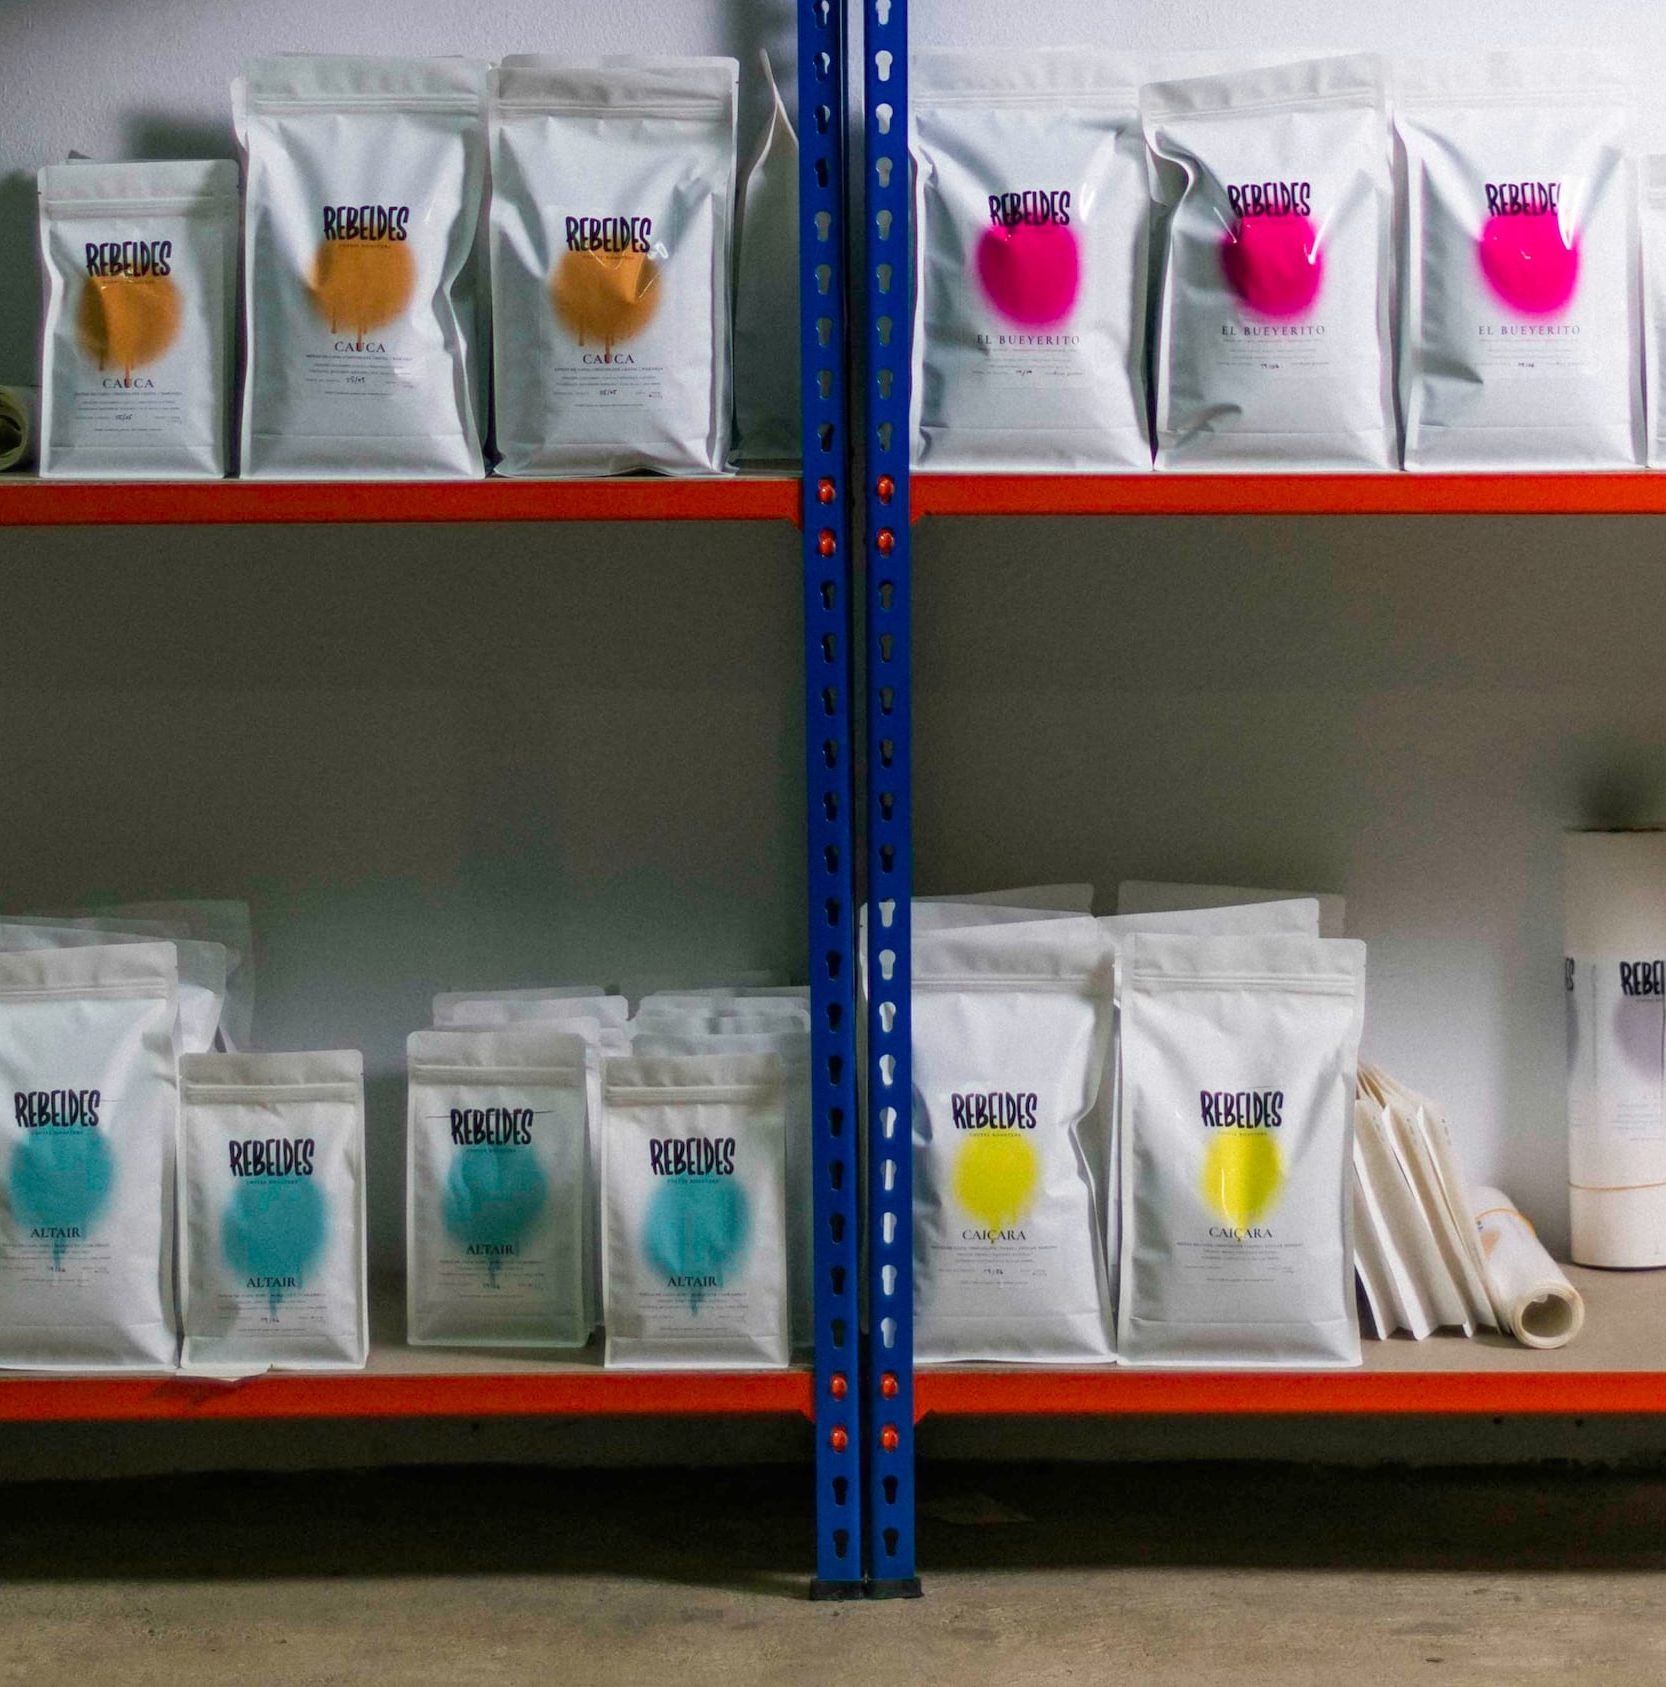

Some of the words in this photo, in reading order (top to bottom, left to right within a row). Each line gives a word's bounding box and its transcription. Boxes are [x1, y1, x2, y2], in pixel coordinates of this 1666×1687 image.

[989, 190, 1071, 226] REBELDES
[1227, 182, 1311, 217] REBELDES
[1485, 182, 1561, 216] REBELDE
[323, 206, 409, 242] REBELDES
[565, 216, 652, 253] REBELDES
[85, 240, 172, 277] REBELDES
[334, 341, 386, 353] CAUCA
[977, 334, 992, 344] EL
[999, 334, 1080, 345] BUEYERITO
[1222, 325, 1237, 335] EL
[1244, 325, 1326, 336] BUEYERITO
[1479, 326, 1493, 335] EL
[1501, 325, 1581, 336] BUEYERITO
[582, 353, 635, 364] CAUCA
[102, 378, 154, 389] CAUCA
[1620, 960, 1665, 996] REBEL
[14, 1089, 100, 1128] REBELDES
[952, 1092, 1038, 1129] REBELDES
[1200, 1091, 1283, 1127] REBELDES
[450, 1108, 533, 1145] REBELDES
[229, 1138, 315, 1177] REBELDES
[649, 1137, 735, 1175] REBELDES
[30, 1227, 80, 1238] ALTAIR
[466, 1244, 514, 1255] ALTAIR
[962, 1229, 1026, 1244] CAIÇARA
[1208, 1227, 1273, 1242] CAIÇARA
[246, 1277, 296, 1288] ALTAIR
[667, 1276, 717, 1288] ALTAIR
